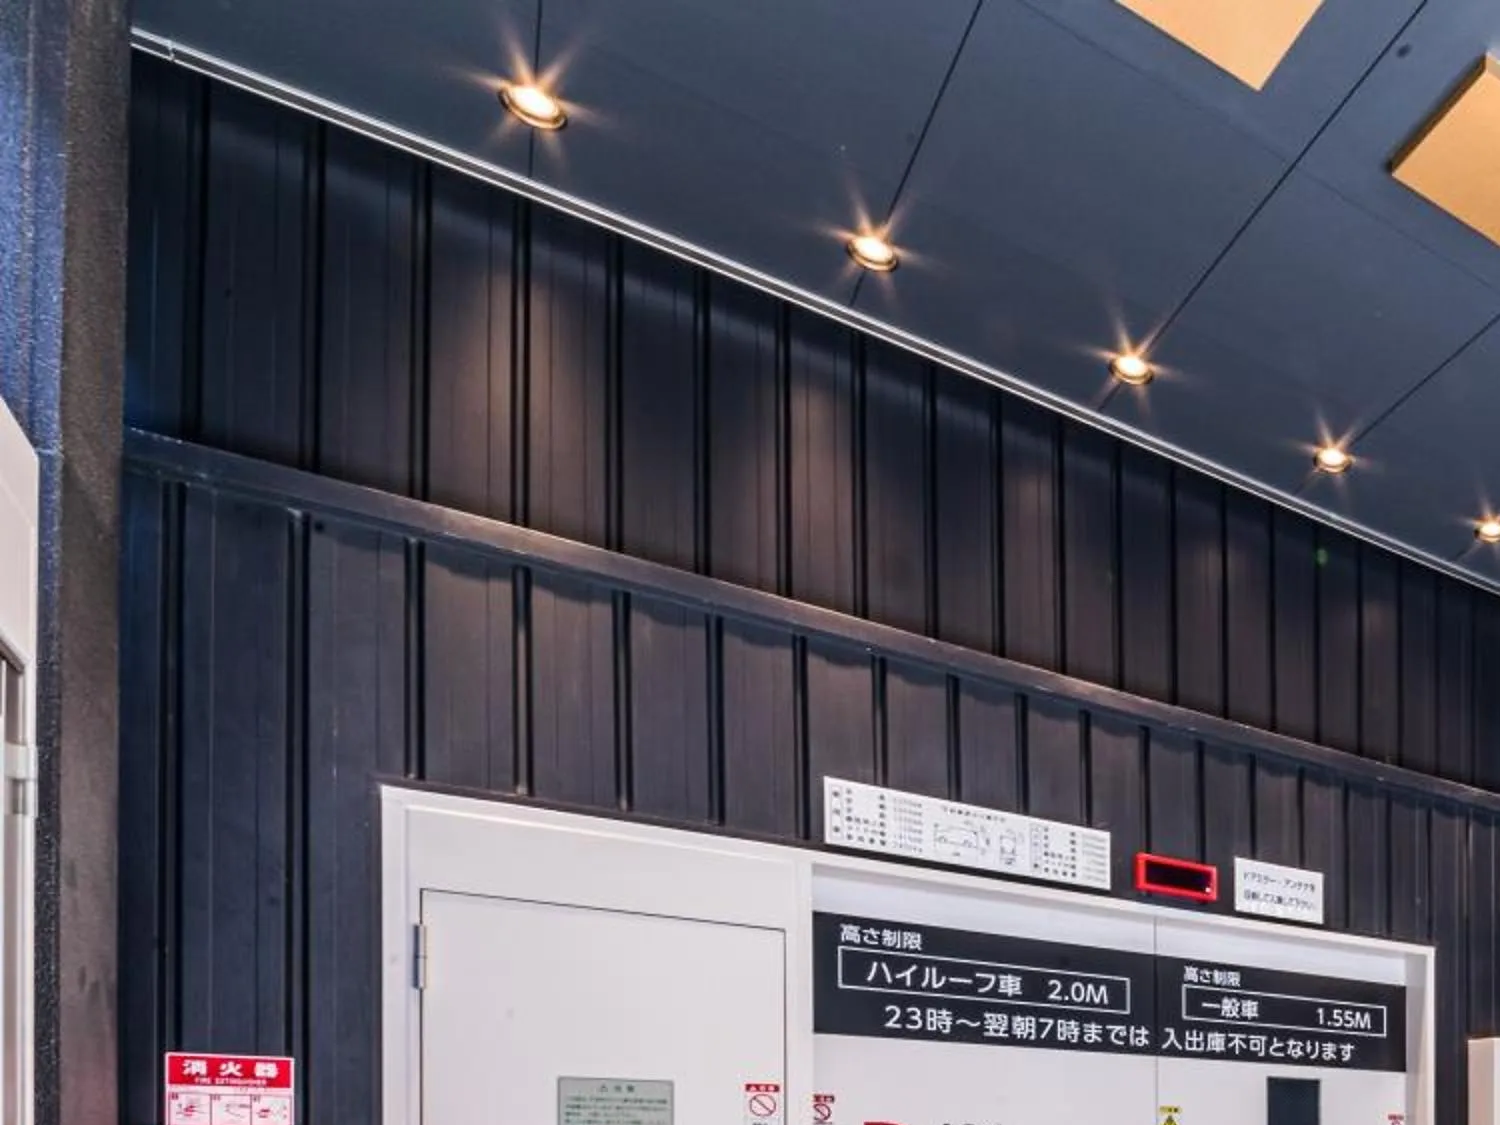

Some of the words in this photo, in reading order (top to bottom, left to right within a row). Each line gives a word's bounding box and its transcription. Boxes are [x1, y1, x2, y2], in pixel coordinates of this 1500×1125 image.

[840, 924, 922, 951] 高さ制限
[867, 961, 1023, 998] ハイルーフ車
[1047, 979, 1109, 1005] 2.0M
[1183, 966, 1241, 987] 高さ制限
[1201, 997, 1259, 1019] 一般車
[1316, 1007, 1372, 1030] 1.55M
[1161, 1026, 1355, 1062] 入出庫不可となります
